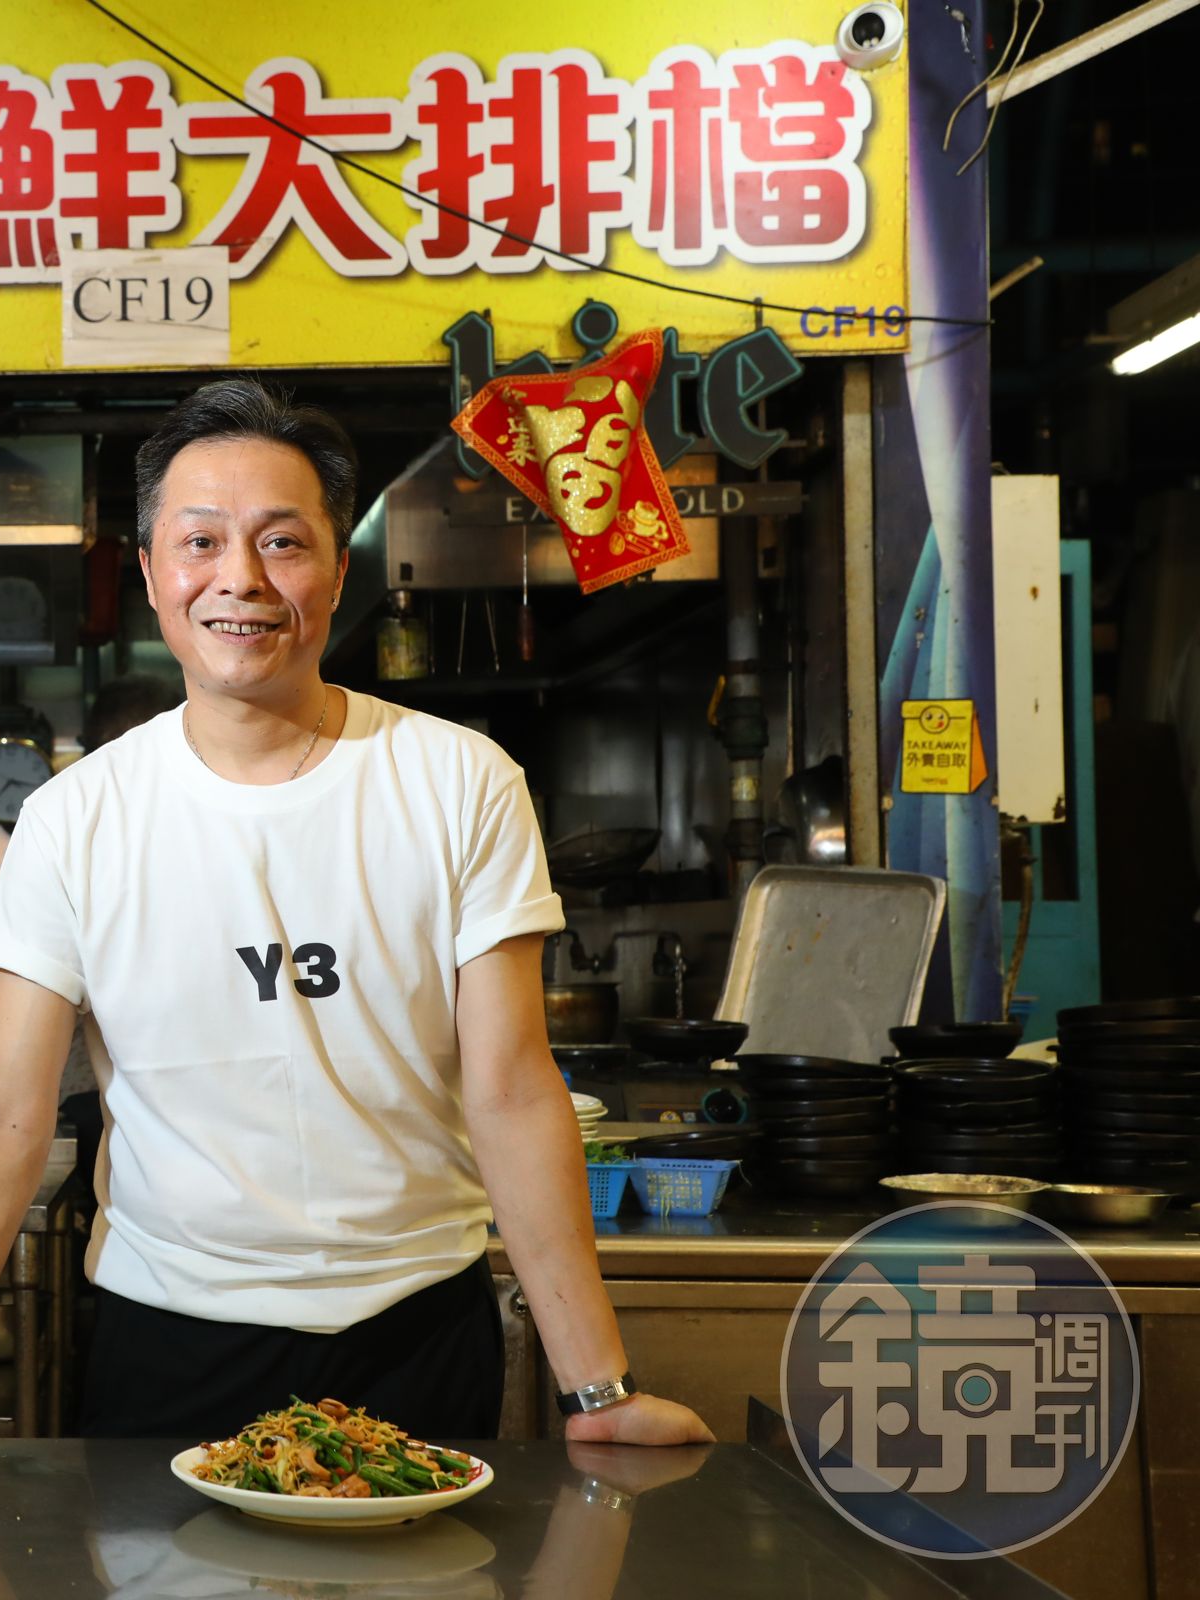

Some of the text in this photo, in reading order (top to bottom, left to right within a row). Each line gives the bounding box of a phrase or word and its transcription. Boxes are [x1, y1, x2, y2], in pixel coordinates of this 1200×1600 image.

[73, 276, 214, 324] CF19
[800, 305, 907, 338] CF19
[672, 486, 745, 514] OLD
[906, 740, 967, 751] TAKEAWAY
[235, 942, 341, 1002] Y3
